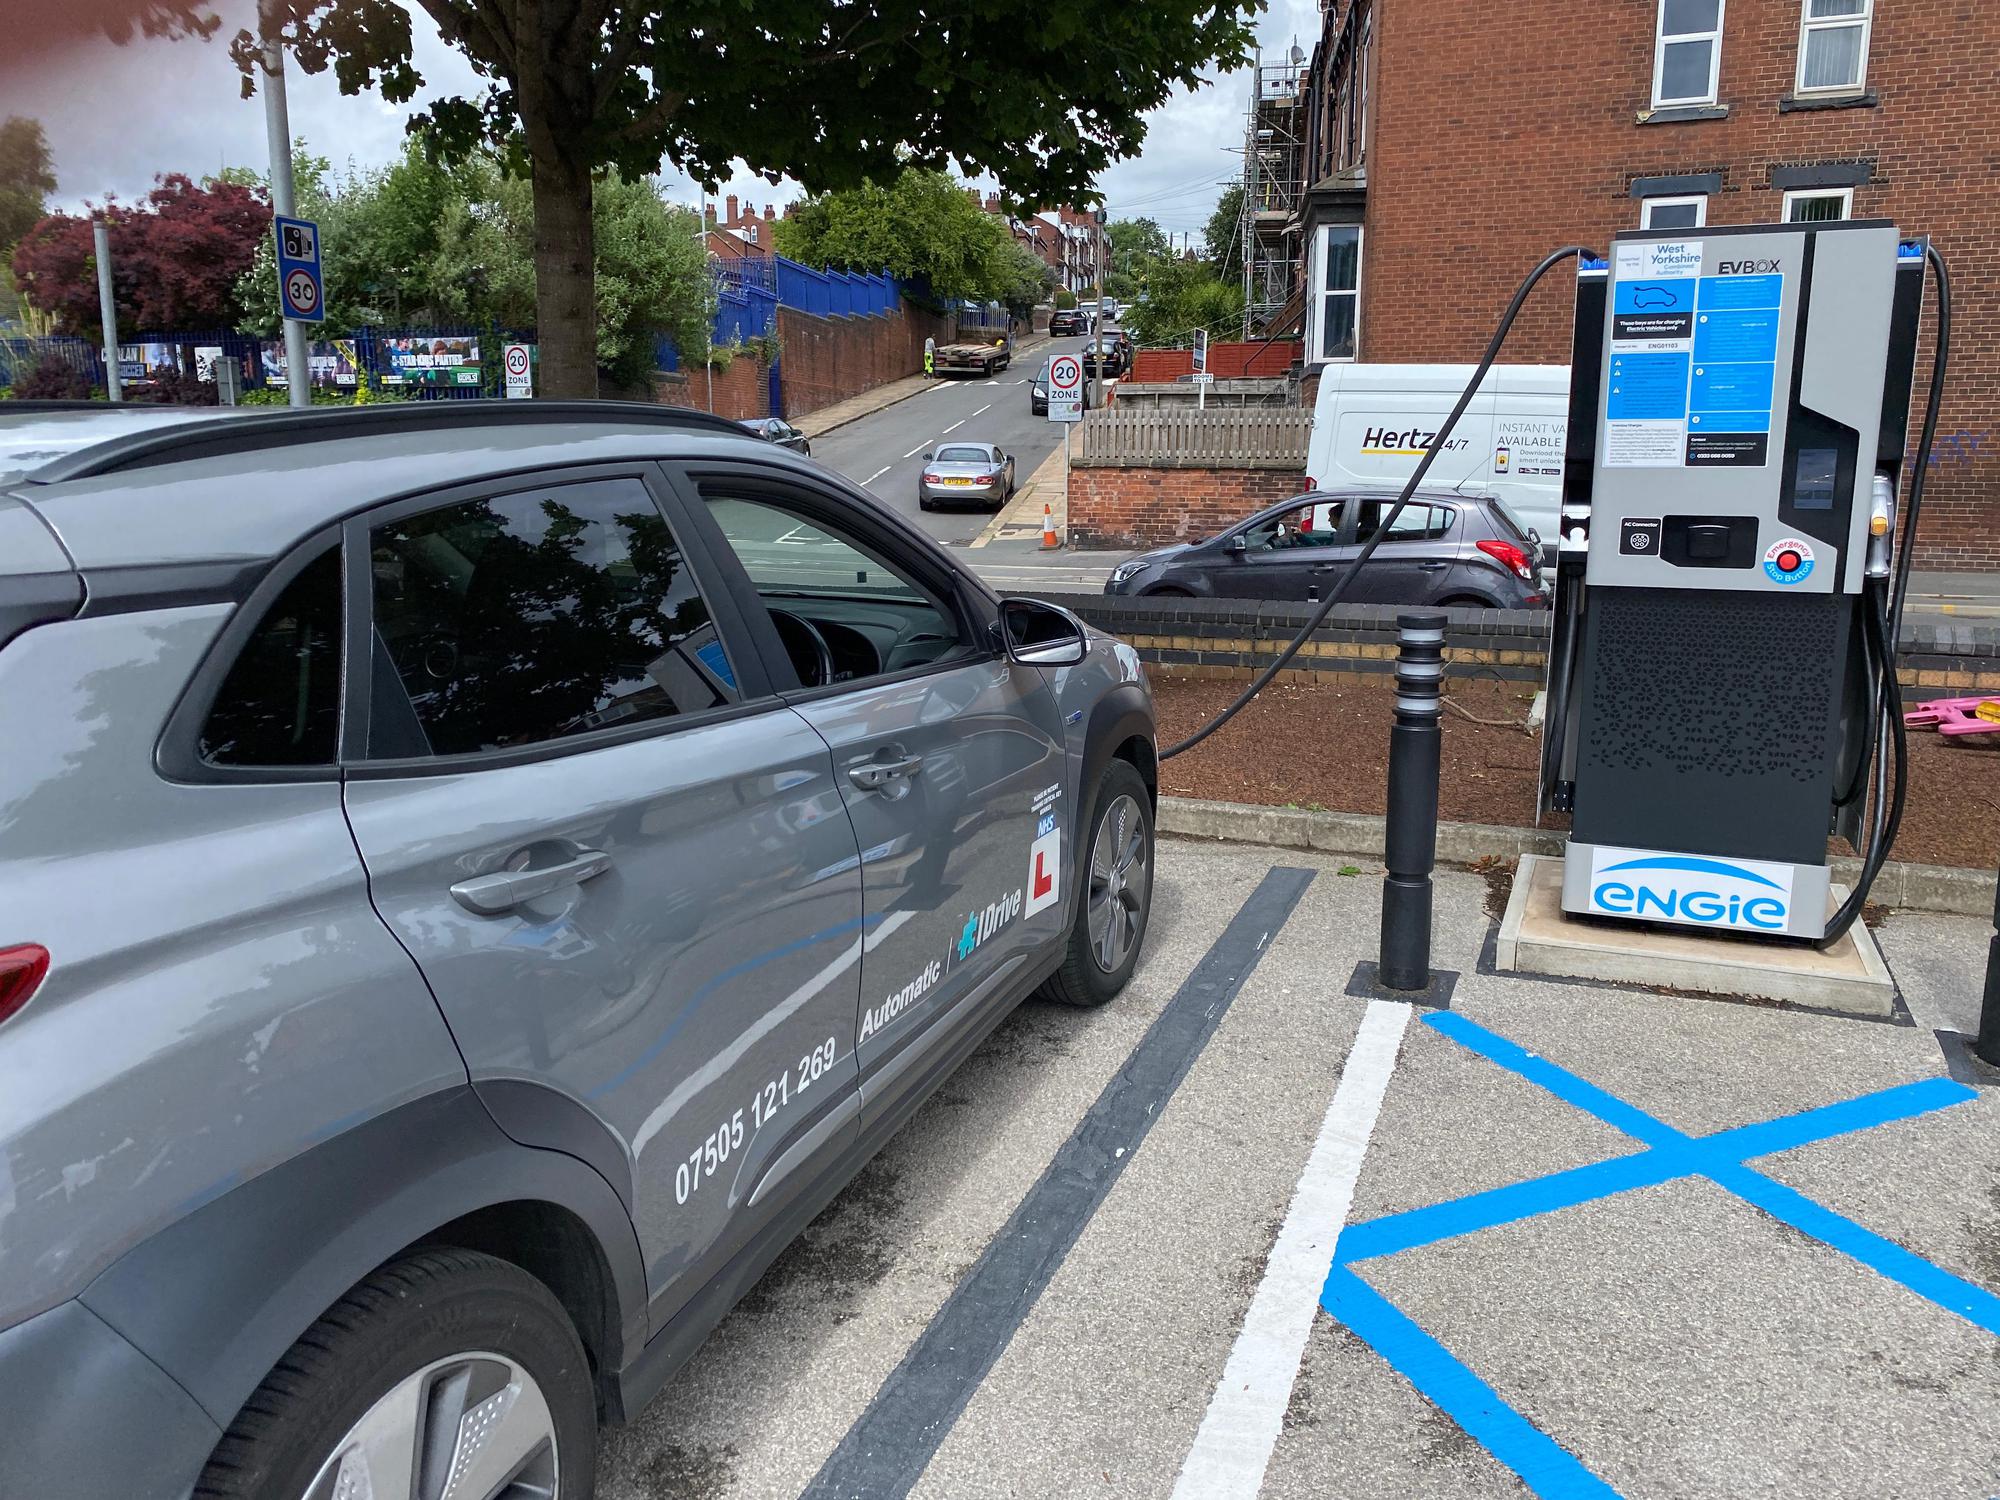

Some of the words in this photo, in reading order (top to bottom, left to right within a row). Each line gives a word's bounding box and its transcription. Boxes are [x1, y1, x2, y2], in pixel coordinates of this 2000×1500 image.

[1657, 244, 1685, 254] West
[1651, 253, 1701, 264] Yorkshire
[1718, 259, 1781, 275] EVBOX
[291, 282, 314, 301] 30
[510, 356, 524, 367] 20
[508, 376, 528, 384] ZONE
[1056, 366, 1076, 379] 20
[1052, 391, 1078, 399] ZONE
[1499, 423, 1548, 433] INSTANT
[1362, 428, 1437, 449] Hertz
[1439, 438, 1469, 451] 4/7
[1497, 436, 1561, 447] AVAILABLE
[1767, 541, 1811, 558] Emergency
[1767, 564, 1783, 581] Stop
[1785, 562, 1811, 582] Button
[1038, 814, 1054, 838] NHS
[1033, 851, 1052, 900] L
[859, 960, 941, 1043] Automatic
[675, 1108, 744, 1205] 07505
[751, 1070, 788, 1129] 121
[797, 1036, 836, 1094] 269
